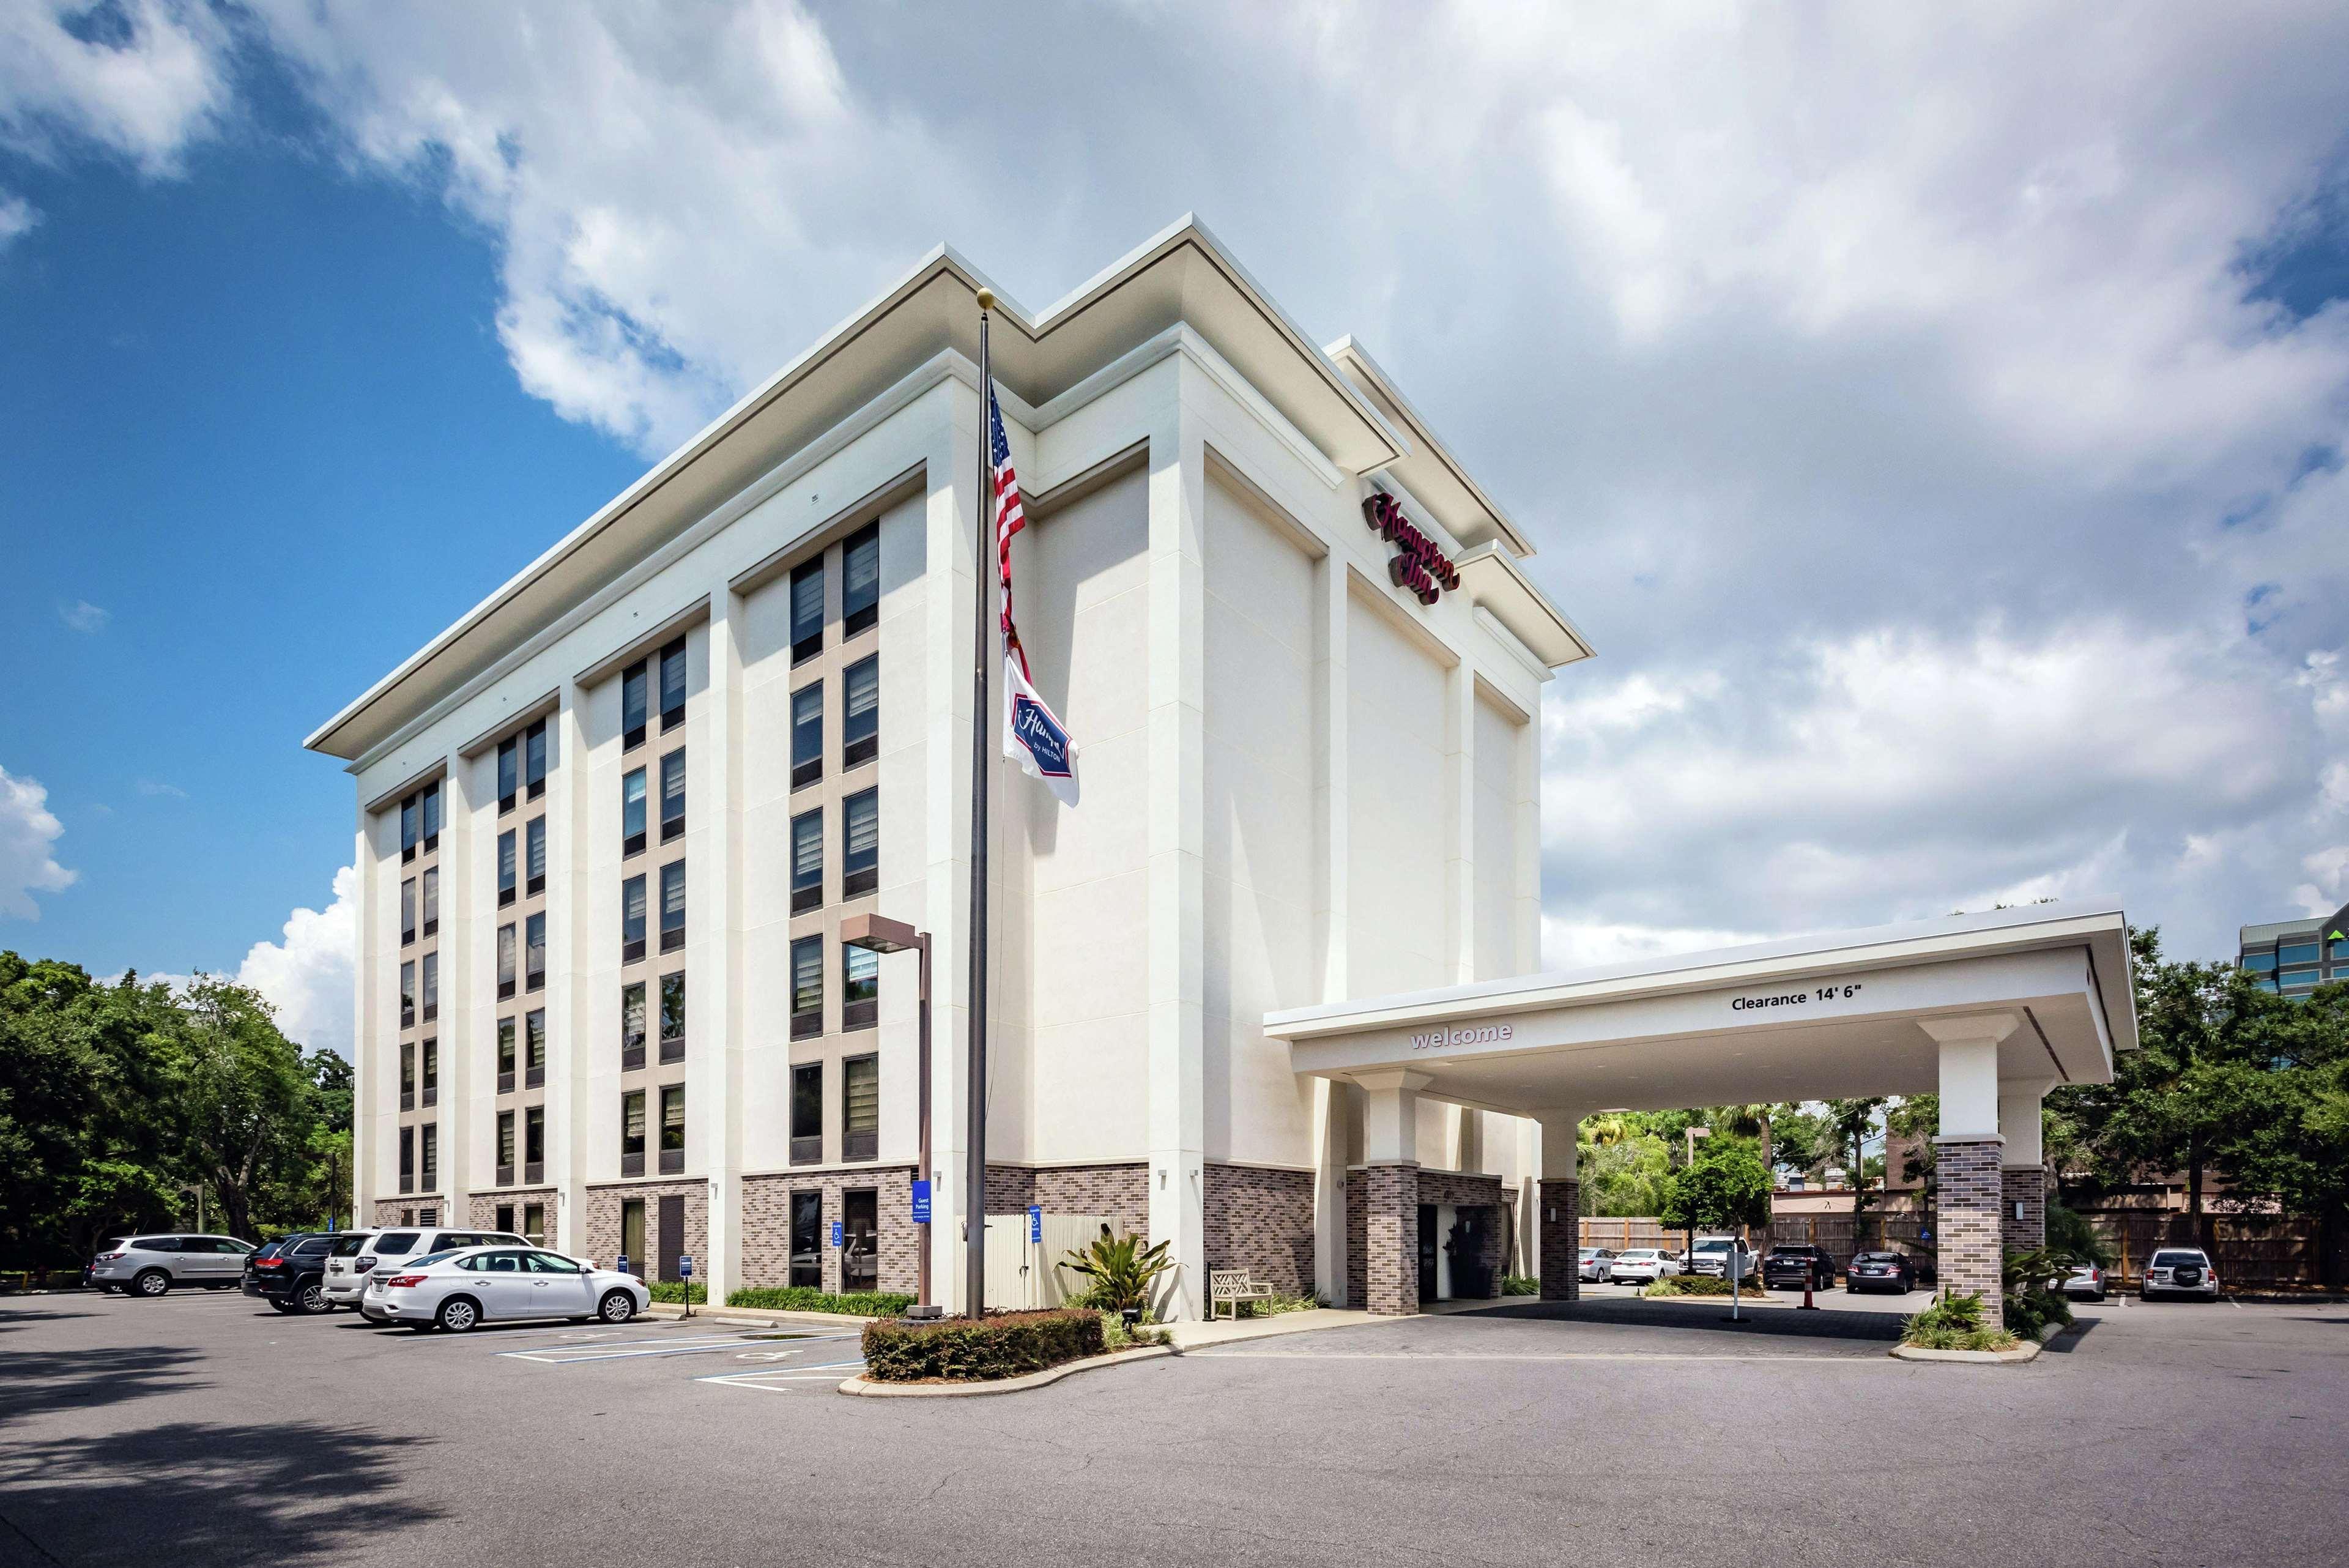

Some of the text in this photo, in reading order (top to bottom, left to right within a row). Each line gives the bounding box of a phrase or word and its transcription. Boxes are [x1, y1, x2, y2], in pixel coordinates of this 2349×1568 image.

[1034, 741, 1061, 763] by HILTON
[1732, 984, 1861, 1010] Clearance 14' 6"
[1411, 1025, 1512, 1050] welcome
